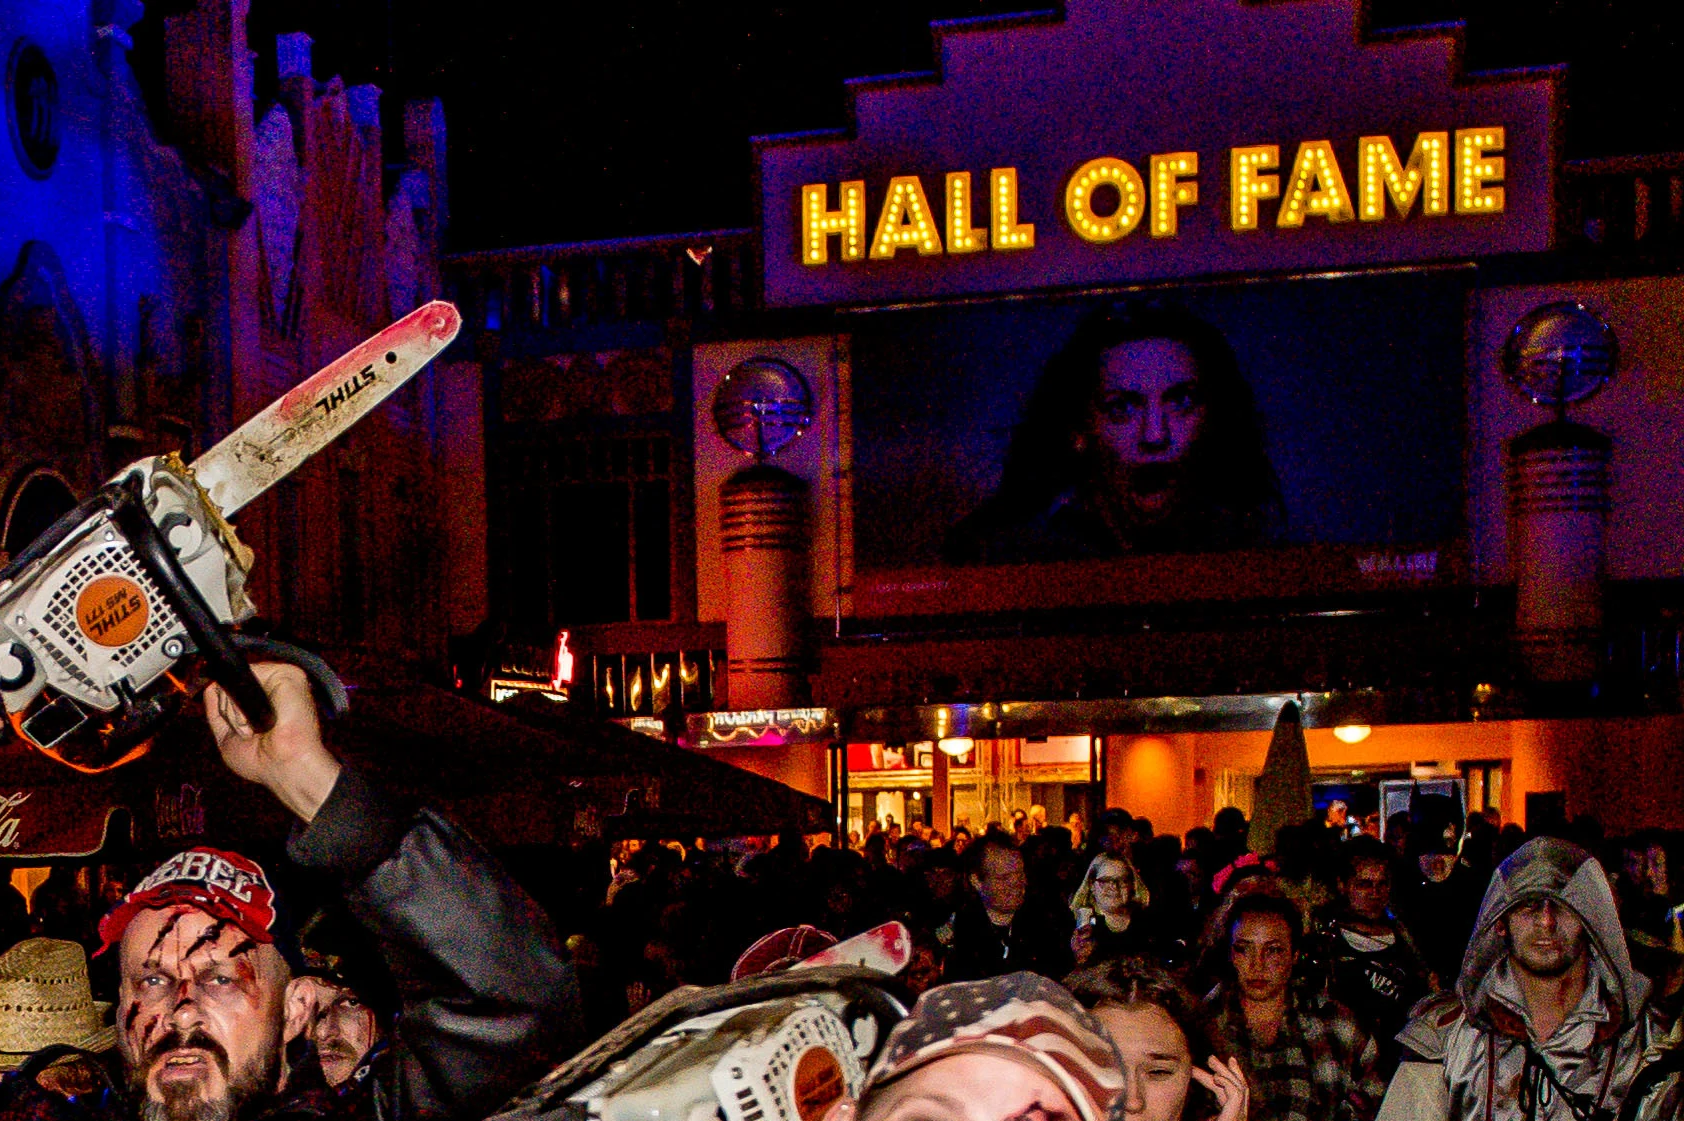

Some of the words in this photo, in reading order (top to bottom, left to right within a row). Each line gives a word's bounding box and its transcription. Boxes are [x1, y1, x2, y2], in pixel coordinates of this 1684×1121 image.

[801, 167, 1035, 267] HALL
[1066, 151, 1199, 242] OF
[1230, 126, 1506, 231] FAME
[315, 363, 376, 416] STIHL
[89, 593, 141, 637] STIHL
